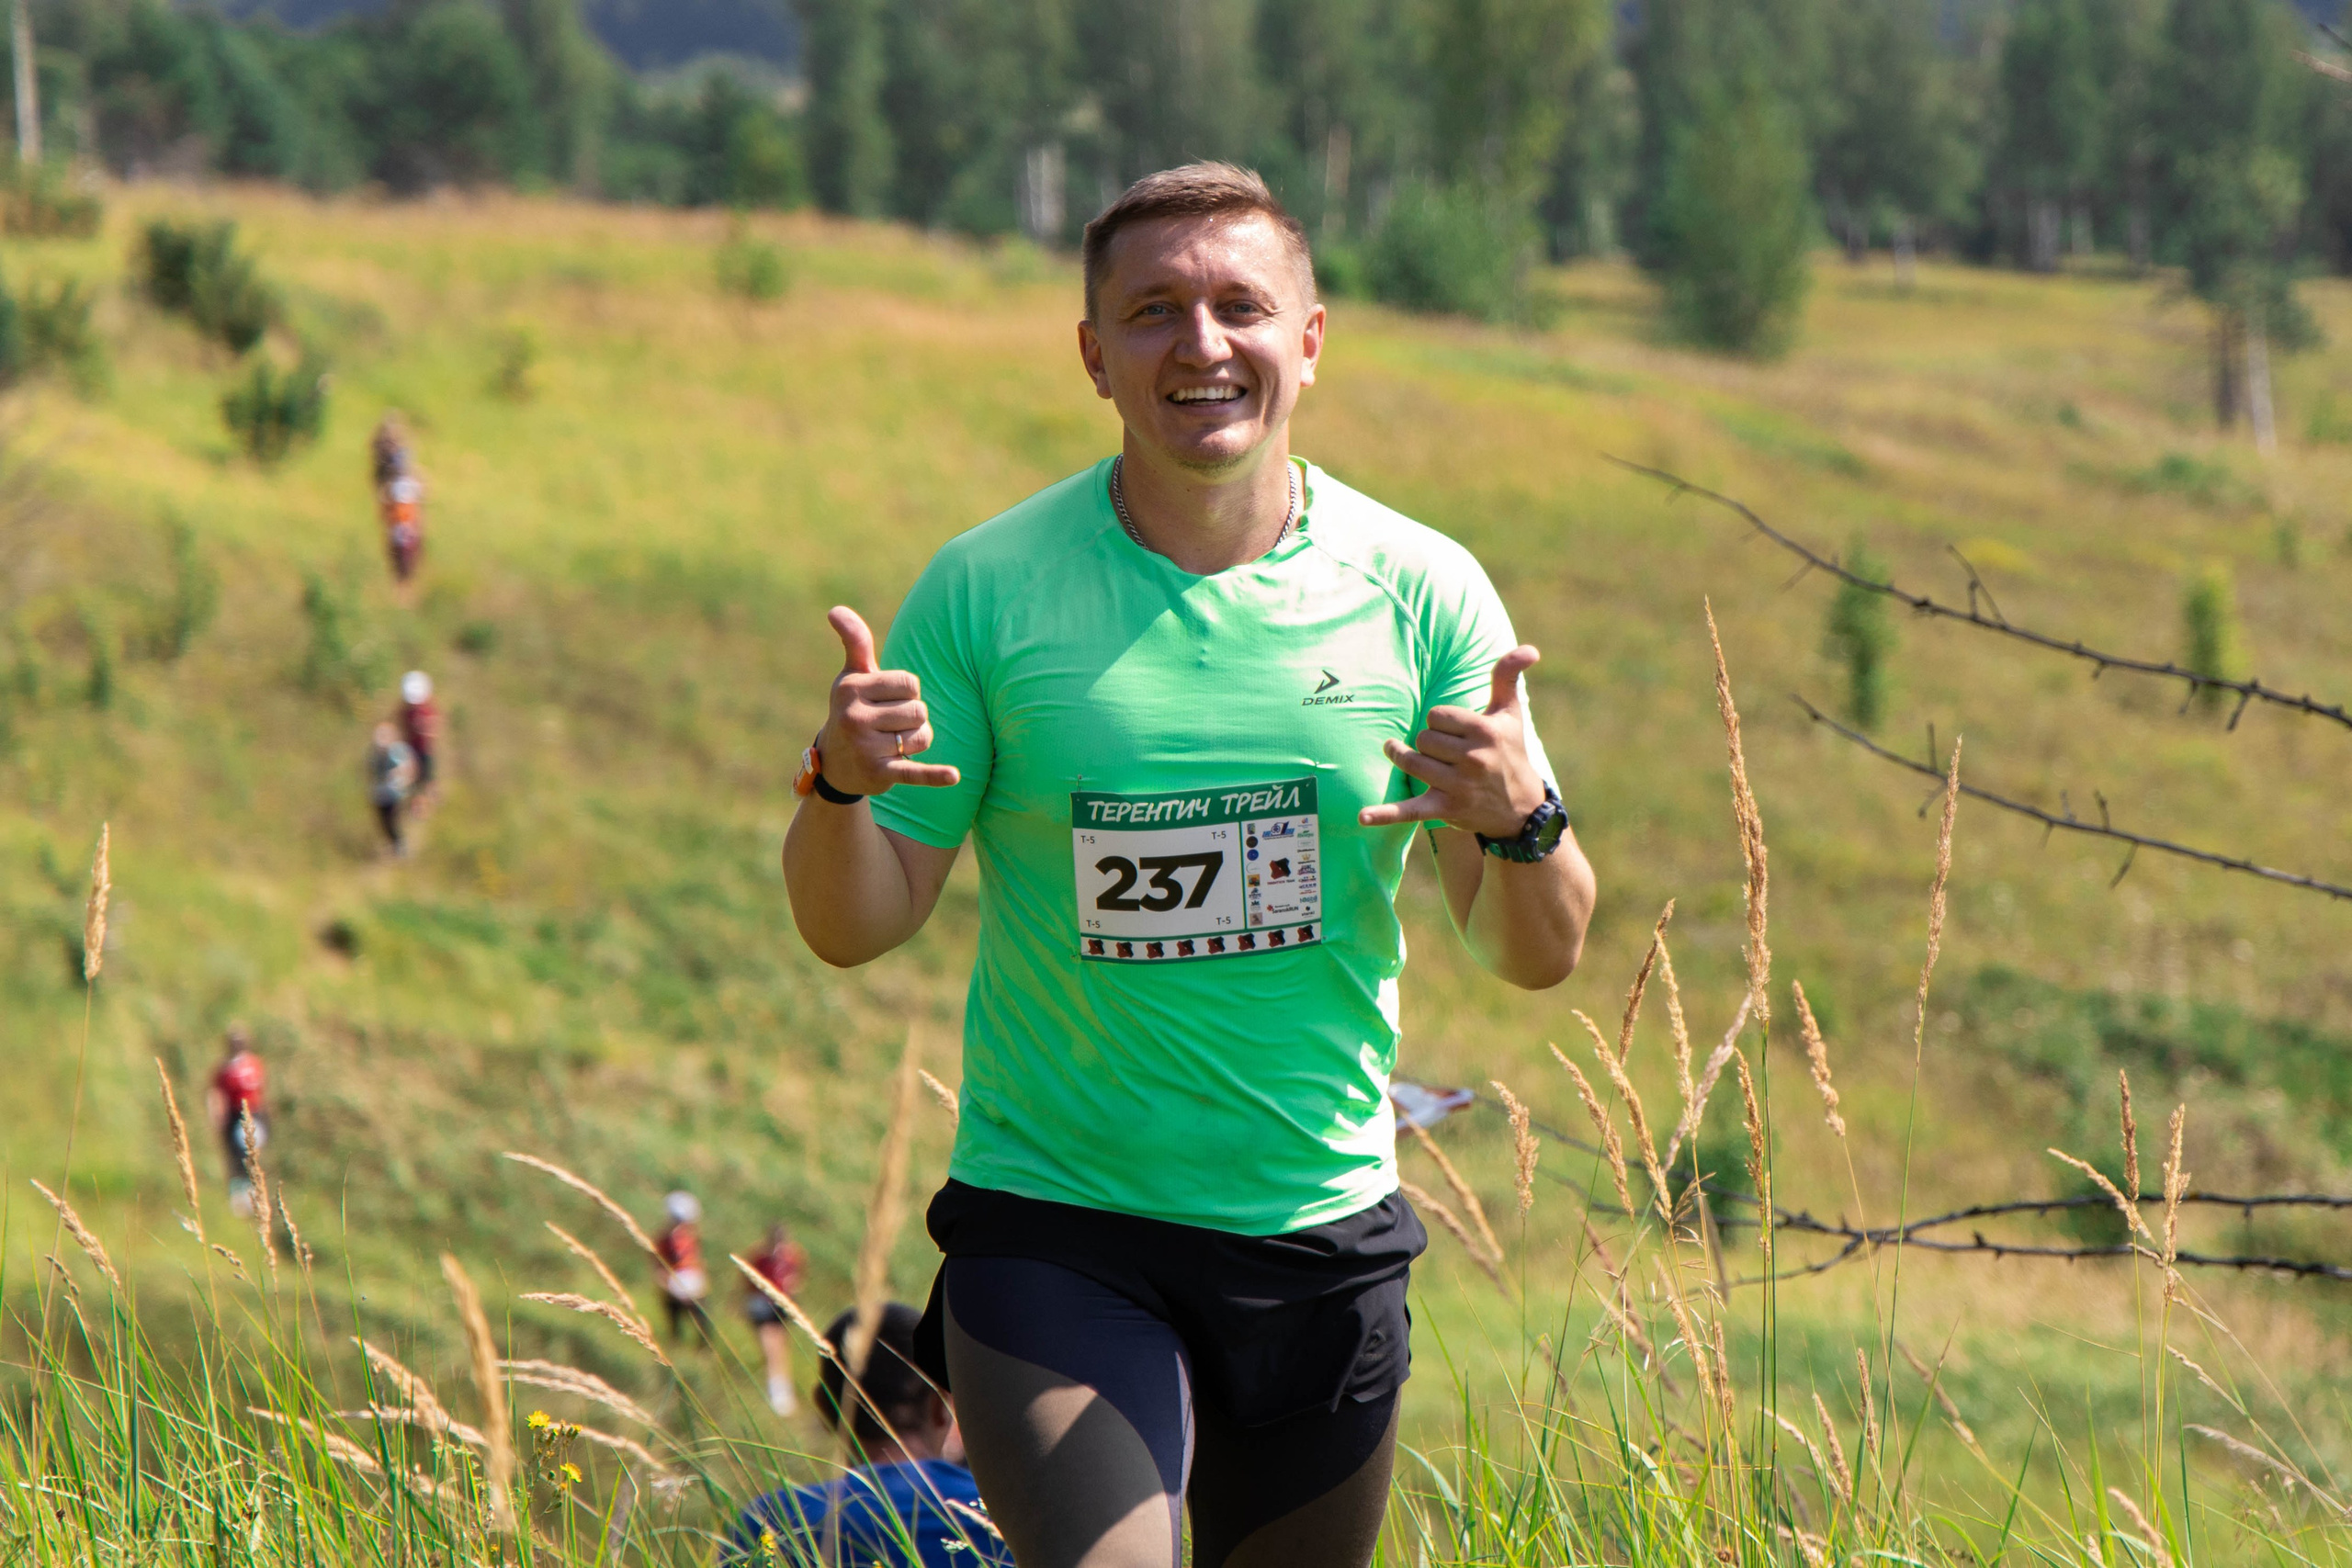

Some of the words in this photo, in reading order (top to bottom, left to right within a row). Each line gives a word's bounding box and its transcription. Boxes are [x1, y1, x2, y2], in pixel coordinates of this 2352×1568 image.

[1302, 694, 1354, 705] DEMIX
[1087, 797, 1211, 823] ТЕРЕНТИЧ
[1220, 784, 1301, 815] ТРЕЙЛ
[1094, 851, 1224, 912] 237
